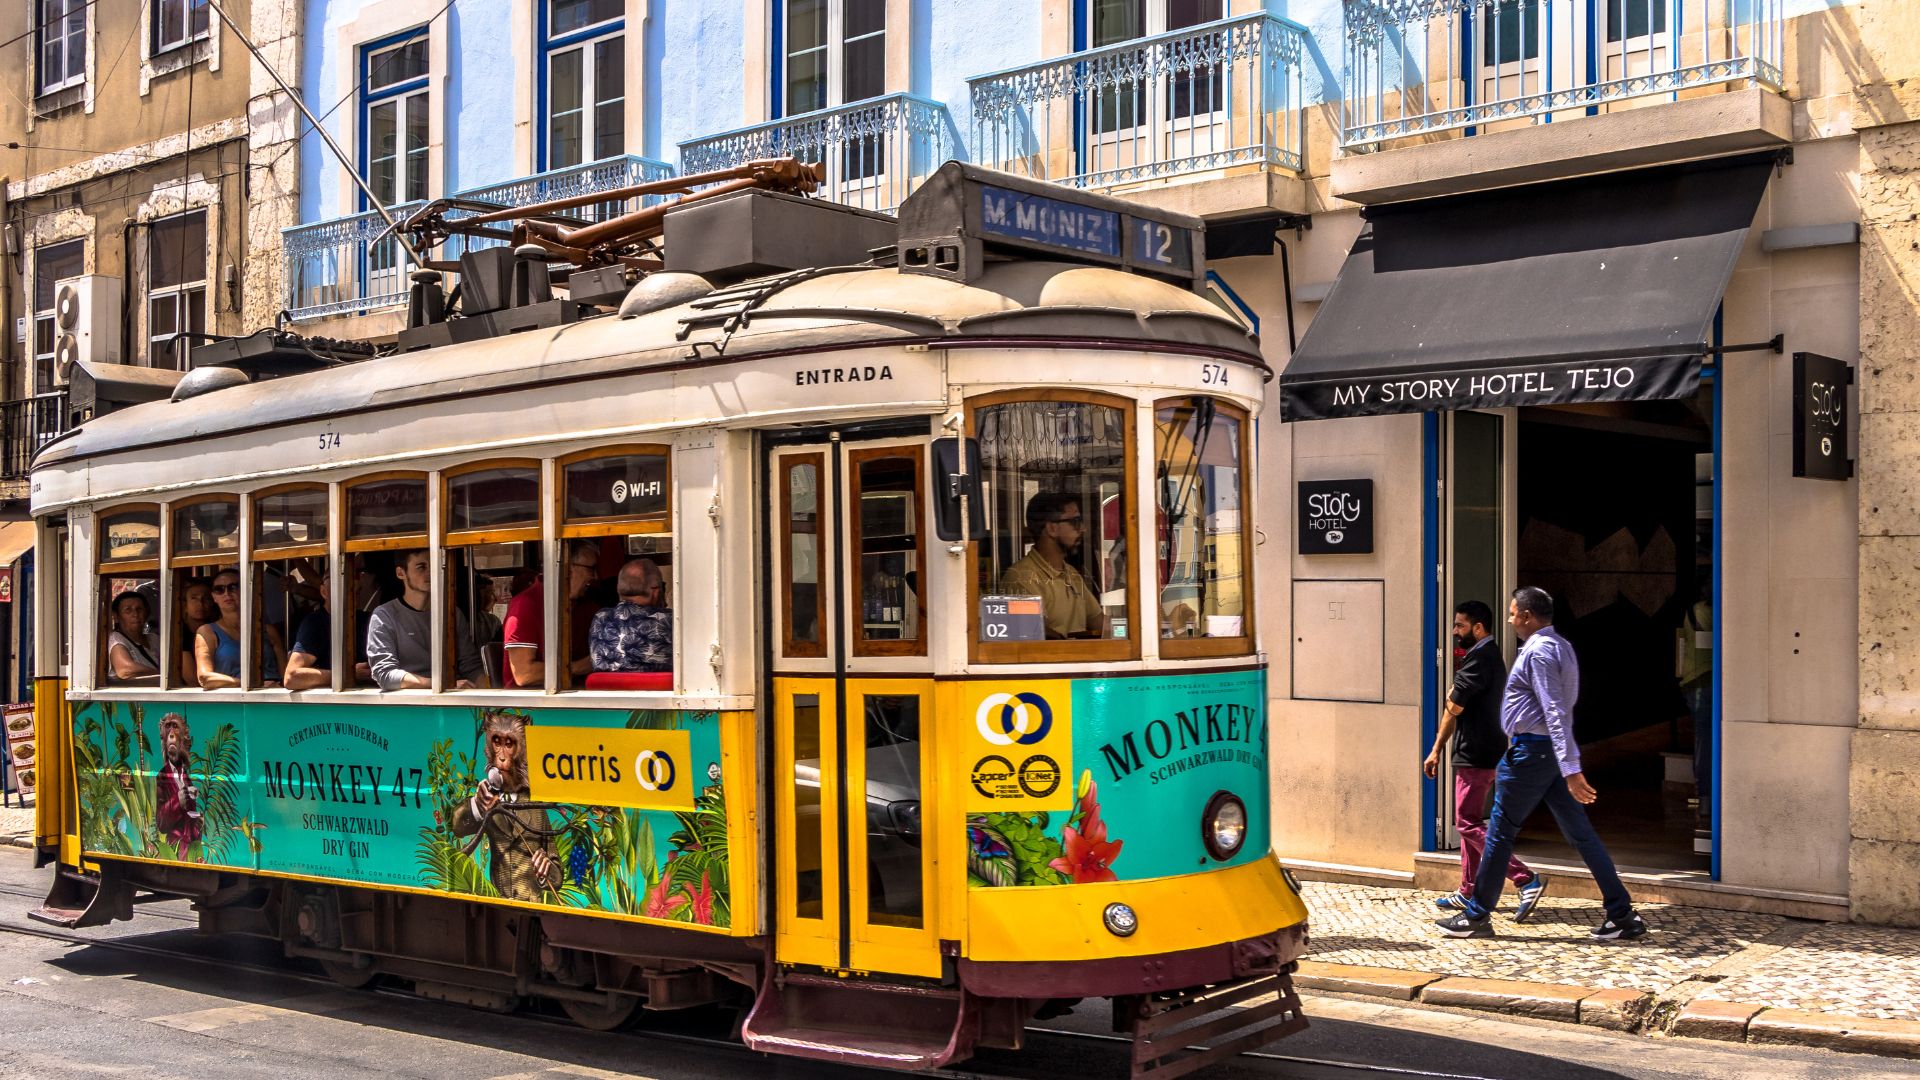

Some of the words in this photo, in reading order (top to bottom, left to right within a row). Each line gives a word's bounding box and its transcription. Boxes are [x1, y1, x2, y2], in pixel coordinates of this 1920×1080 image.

[1142, 222, 1173, 264] 12
[795, 365, 893, 386] ENTRADA
[1202, 364, 1229, 386] 574
[1333, 385, 1371, 406] MY
[1381, 377, 1461, 402] STORY
[1470, 372, 1554, 397] HOTEL
[1567, 367, 1635, 389] TEJO
[318, 432, 341, 450] 574
[629, 481, 661, 498] WI-FI
[1309, 518, 1348, 530] HOTEL
[985, 604, 1007, 615] 12E
[986, 623, 1009, 638] 02
[288, 722, 332, 748] CERTAINLY
[334, 722, 389, 751] WUNDERBAR
[1099, 703, 1256, 783] MONKEY
[542, 744, 621, 783] carris
[1149, 748, 1234, 785] SCHWARZWALD
[263, 760, 383, 805] MONKEY
[392, 767, 423, 809] 47
[303, 813, 389, 837] SCHWARZWALD
[322, 838, 345, 857] DRY
[350, 841, 370, 859] GIN
